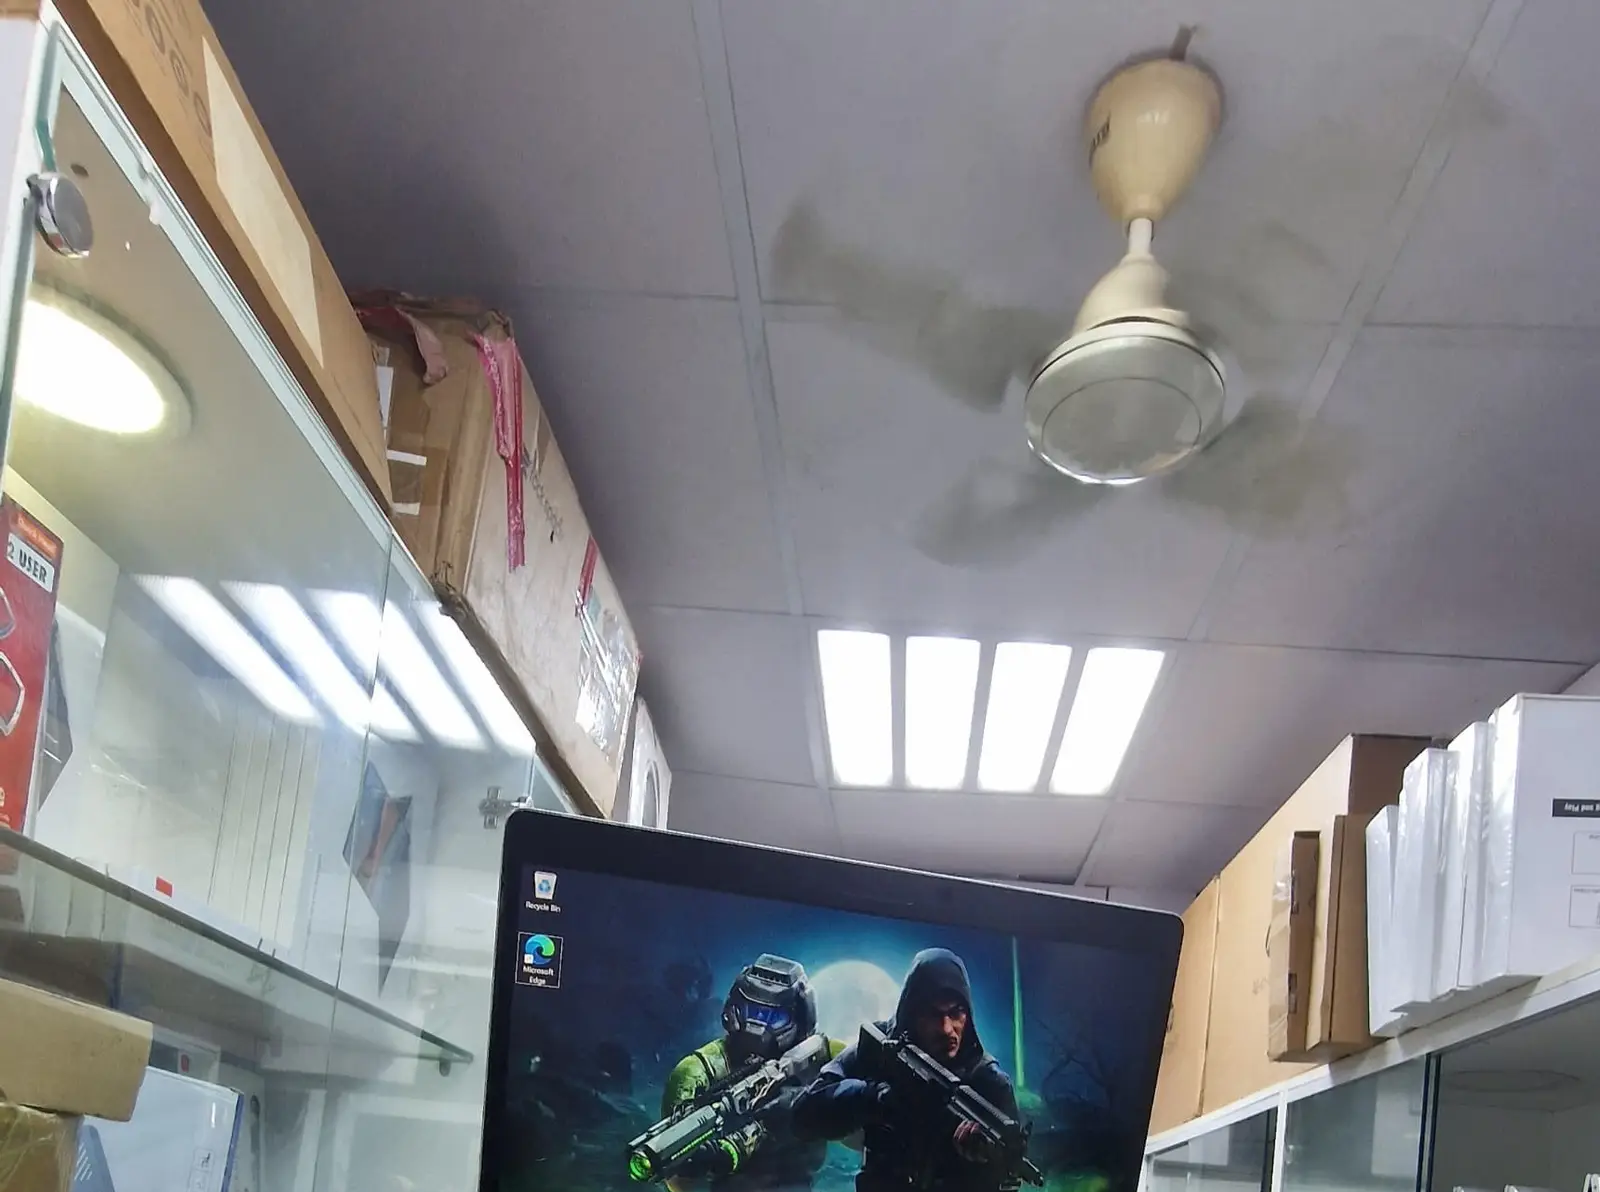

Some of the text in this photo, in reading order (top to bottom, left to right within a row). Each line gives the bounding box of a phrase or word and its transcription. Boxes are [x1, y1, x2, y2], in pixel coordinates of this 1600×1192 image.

[18, 548, 48, 584] USER
[1563, 802, 1580, 813] Play
[525, 901, 561, 913] Recycle Bin
[523, 965, 554, 977] Microsoft
[529, 976, 546, 987] Edge
